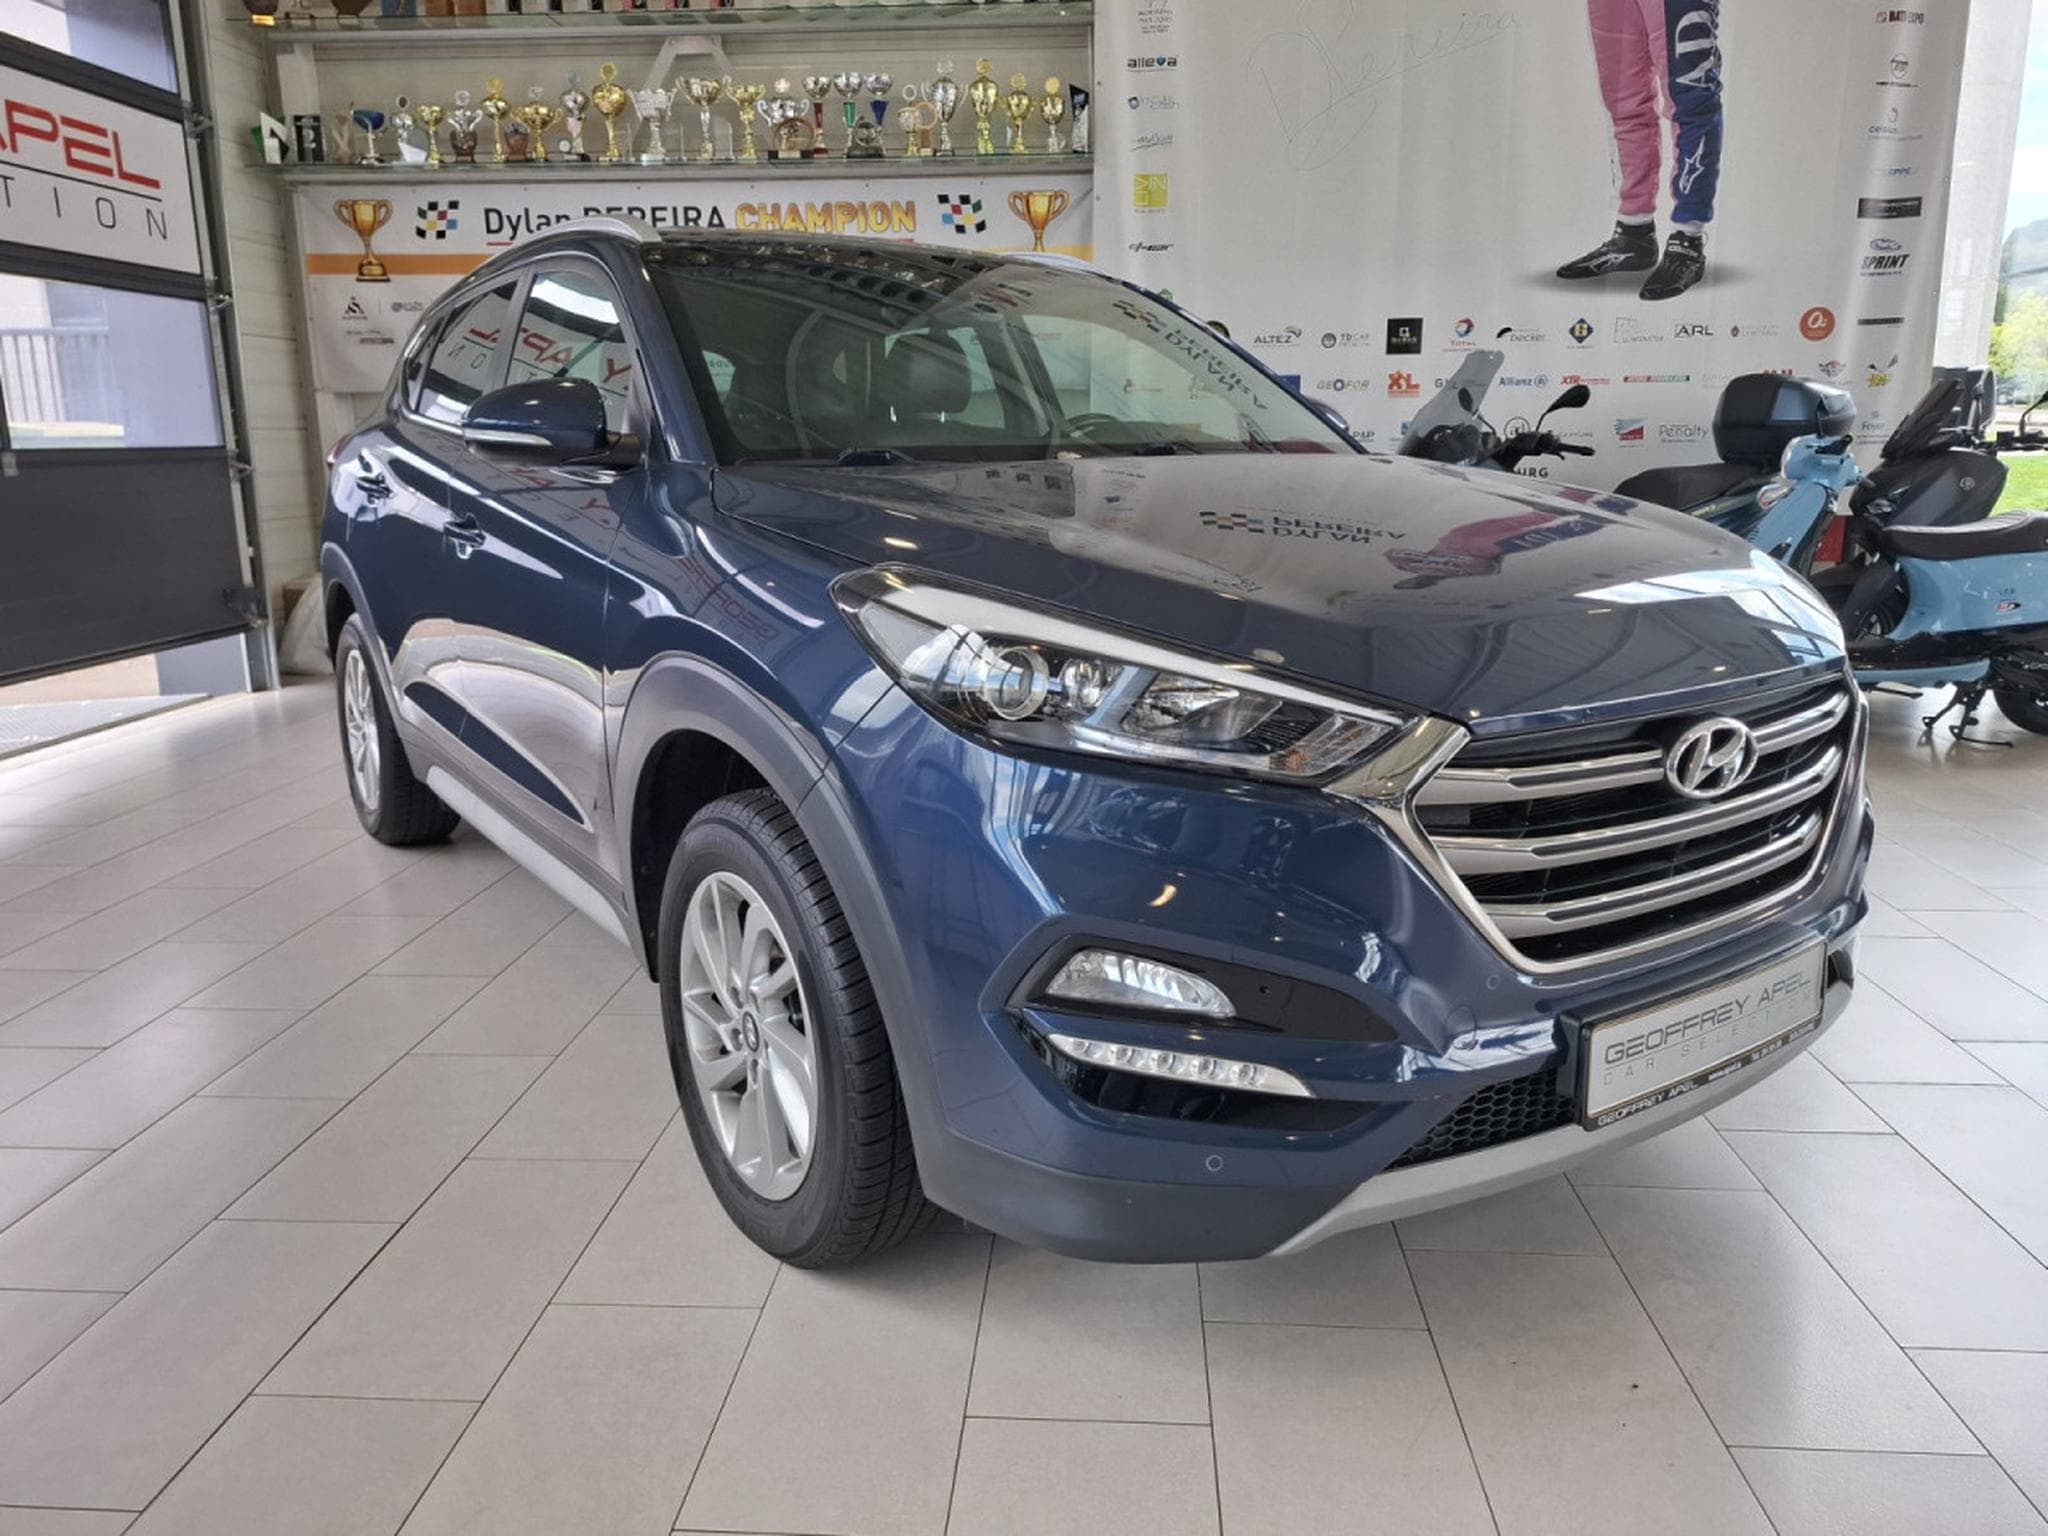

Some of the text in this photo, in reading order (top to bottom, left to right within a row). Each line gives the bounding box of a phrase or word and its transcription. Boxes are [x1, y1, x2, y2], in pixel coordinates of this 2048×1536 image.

[0, 100, 160, 189] PEL
[484, 207, 570, 240] Dylan
[735, 200, 917, 233] CHAMPION
[1861, 254, 1910, 269] SPRINT
[1675, 324, 1714, 337] ARL
[1254, 335, 1292, 344] ALTEZ
[1499, 377, 1533, 387] Allianz
[1659, 424, 1709, 438] Penalty
[1604, 995, 1749, 1064] GEOFFREY
[1757, 971, 1811, 1007] APEL
